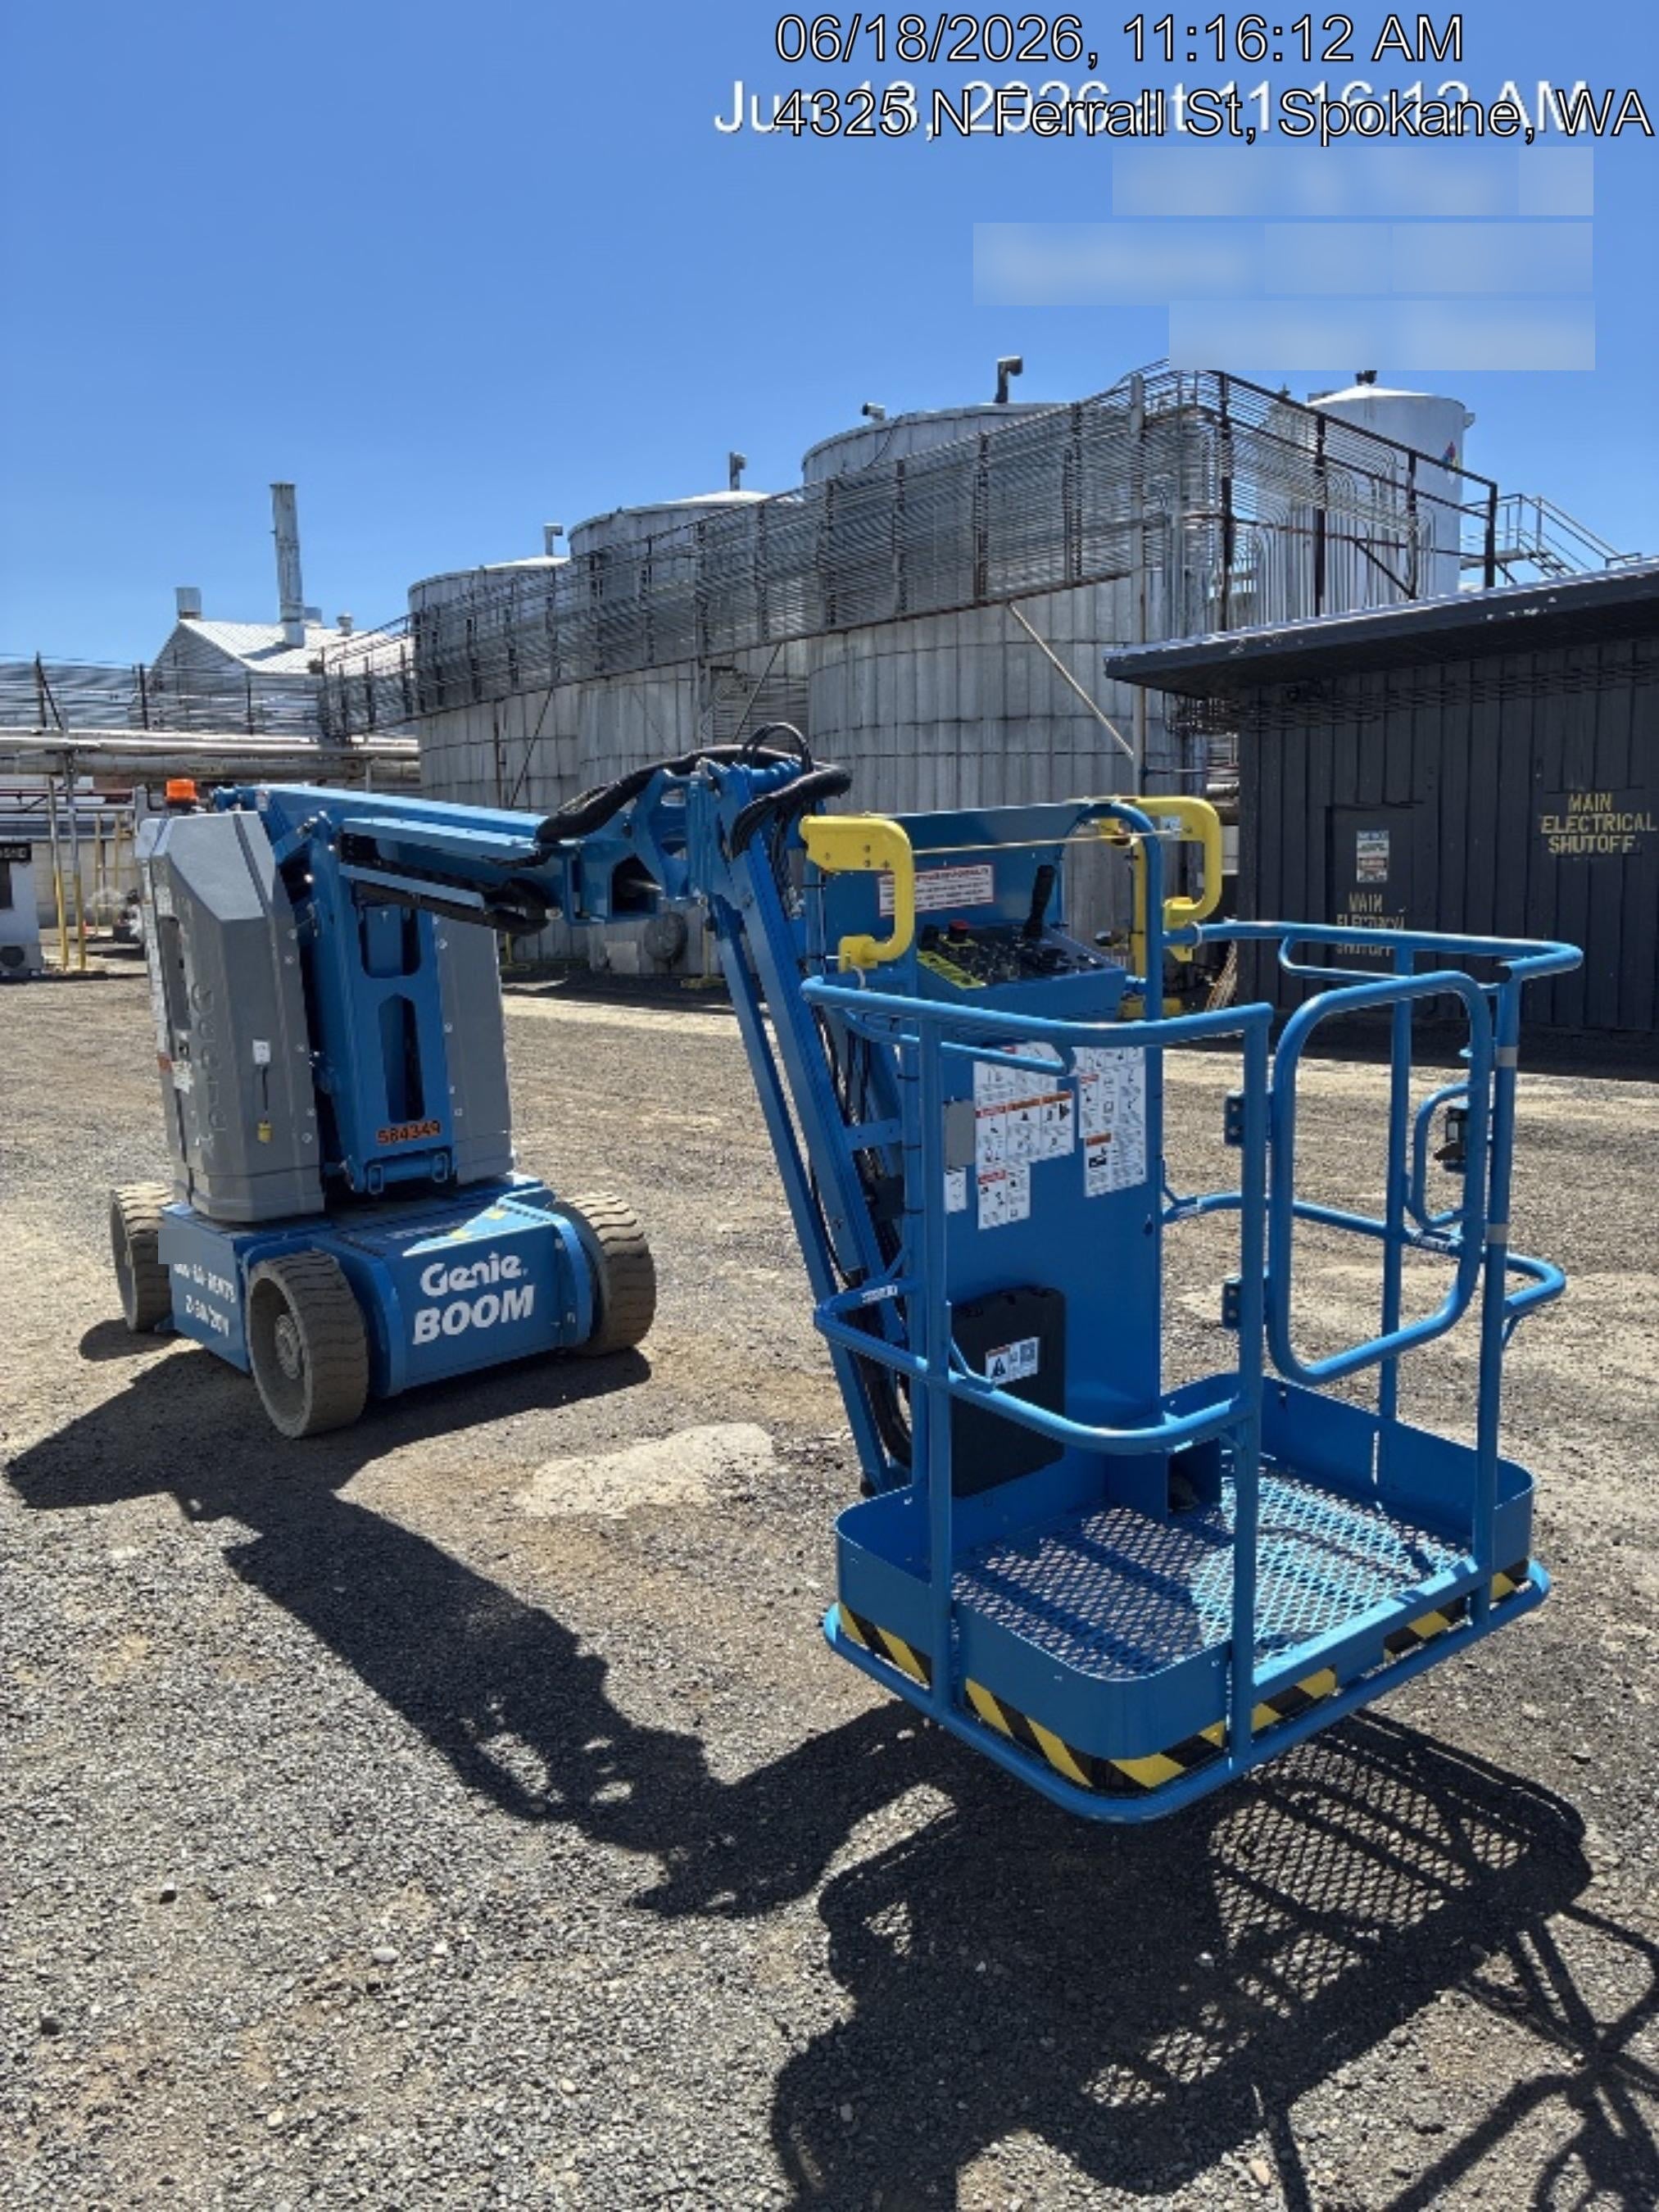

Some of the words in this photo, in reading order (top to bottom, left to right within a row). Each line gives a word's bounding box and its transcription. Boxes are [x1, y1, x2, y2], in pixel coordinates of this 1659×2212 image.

[1568, 792, 1612, 813] MAIN
[1541, 813, 1657, 834] ELECTRICAL
[1548, 834, 1635, 854] SHUTOFF
[1349, 891, 1383, 913] MAIN
[420, 1251, 523, 1297] Genie
[412, 1283, 535, 1345] BOOM
